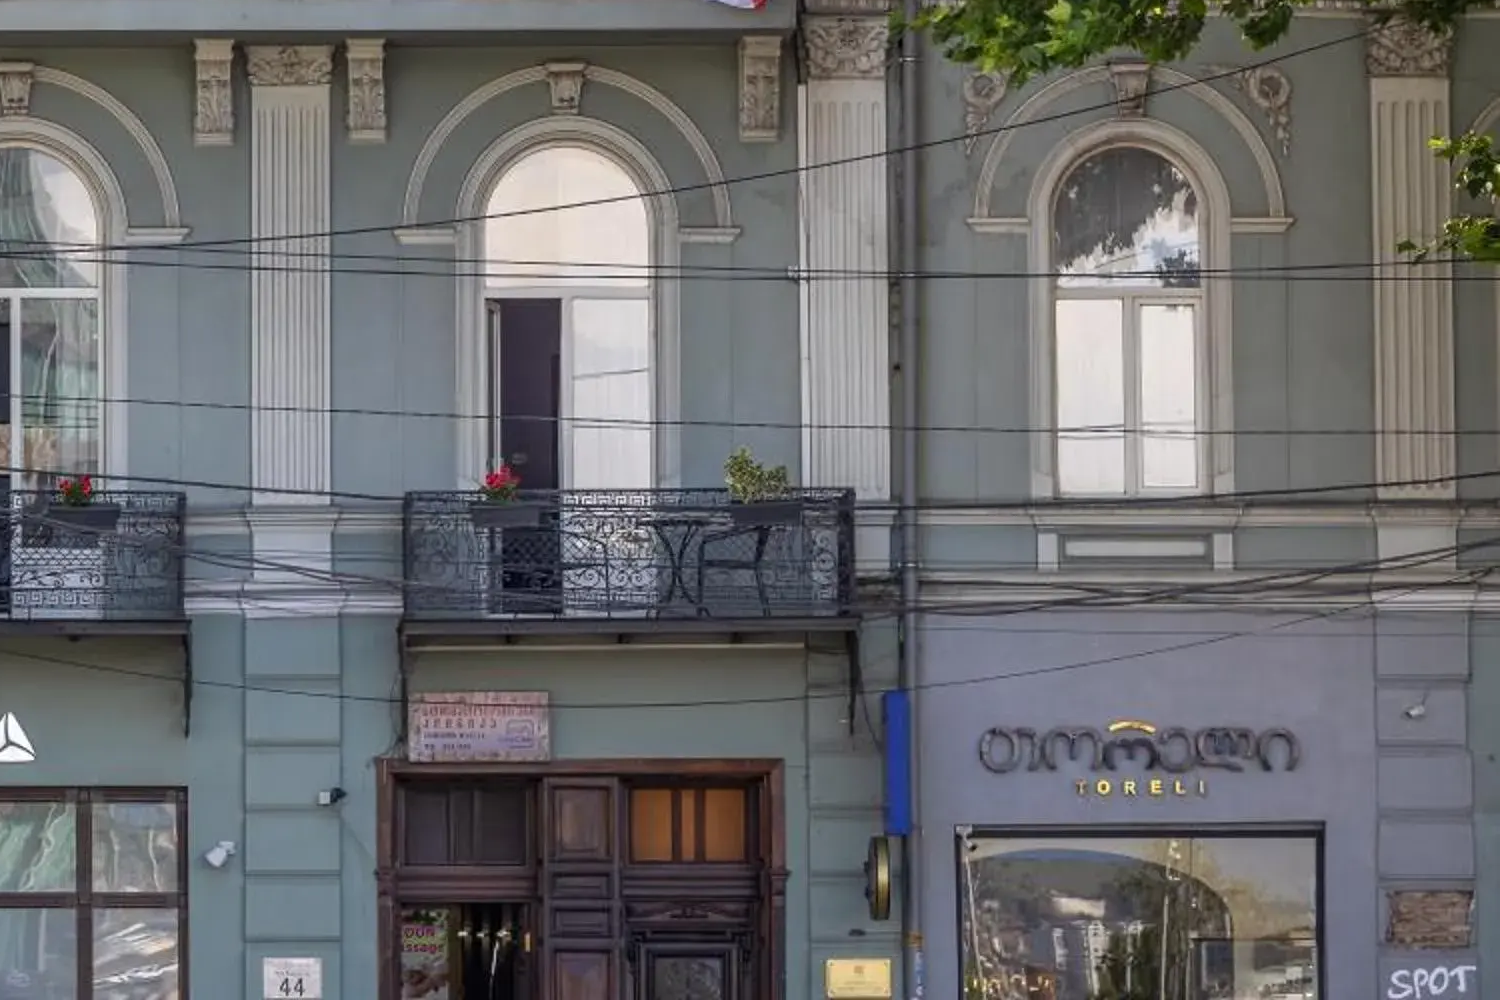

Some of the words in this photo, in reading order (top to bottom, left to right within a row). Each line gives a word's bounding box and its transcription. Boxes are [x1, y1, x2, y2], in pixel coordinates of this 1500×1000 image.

[1075, 779, 1208, 796] TORELI
[279, 977, 307, 997] 44
[1387, 965, 1477, 999] SPOT
